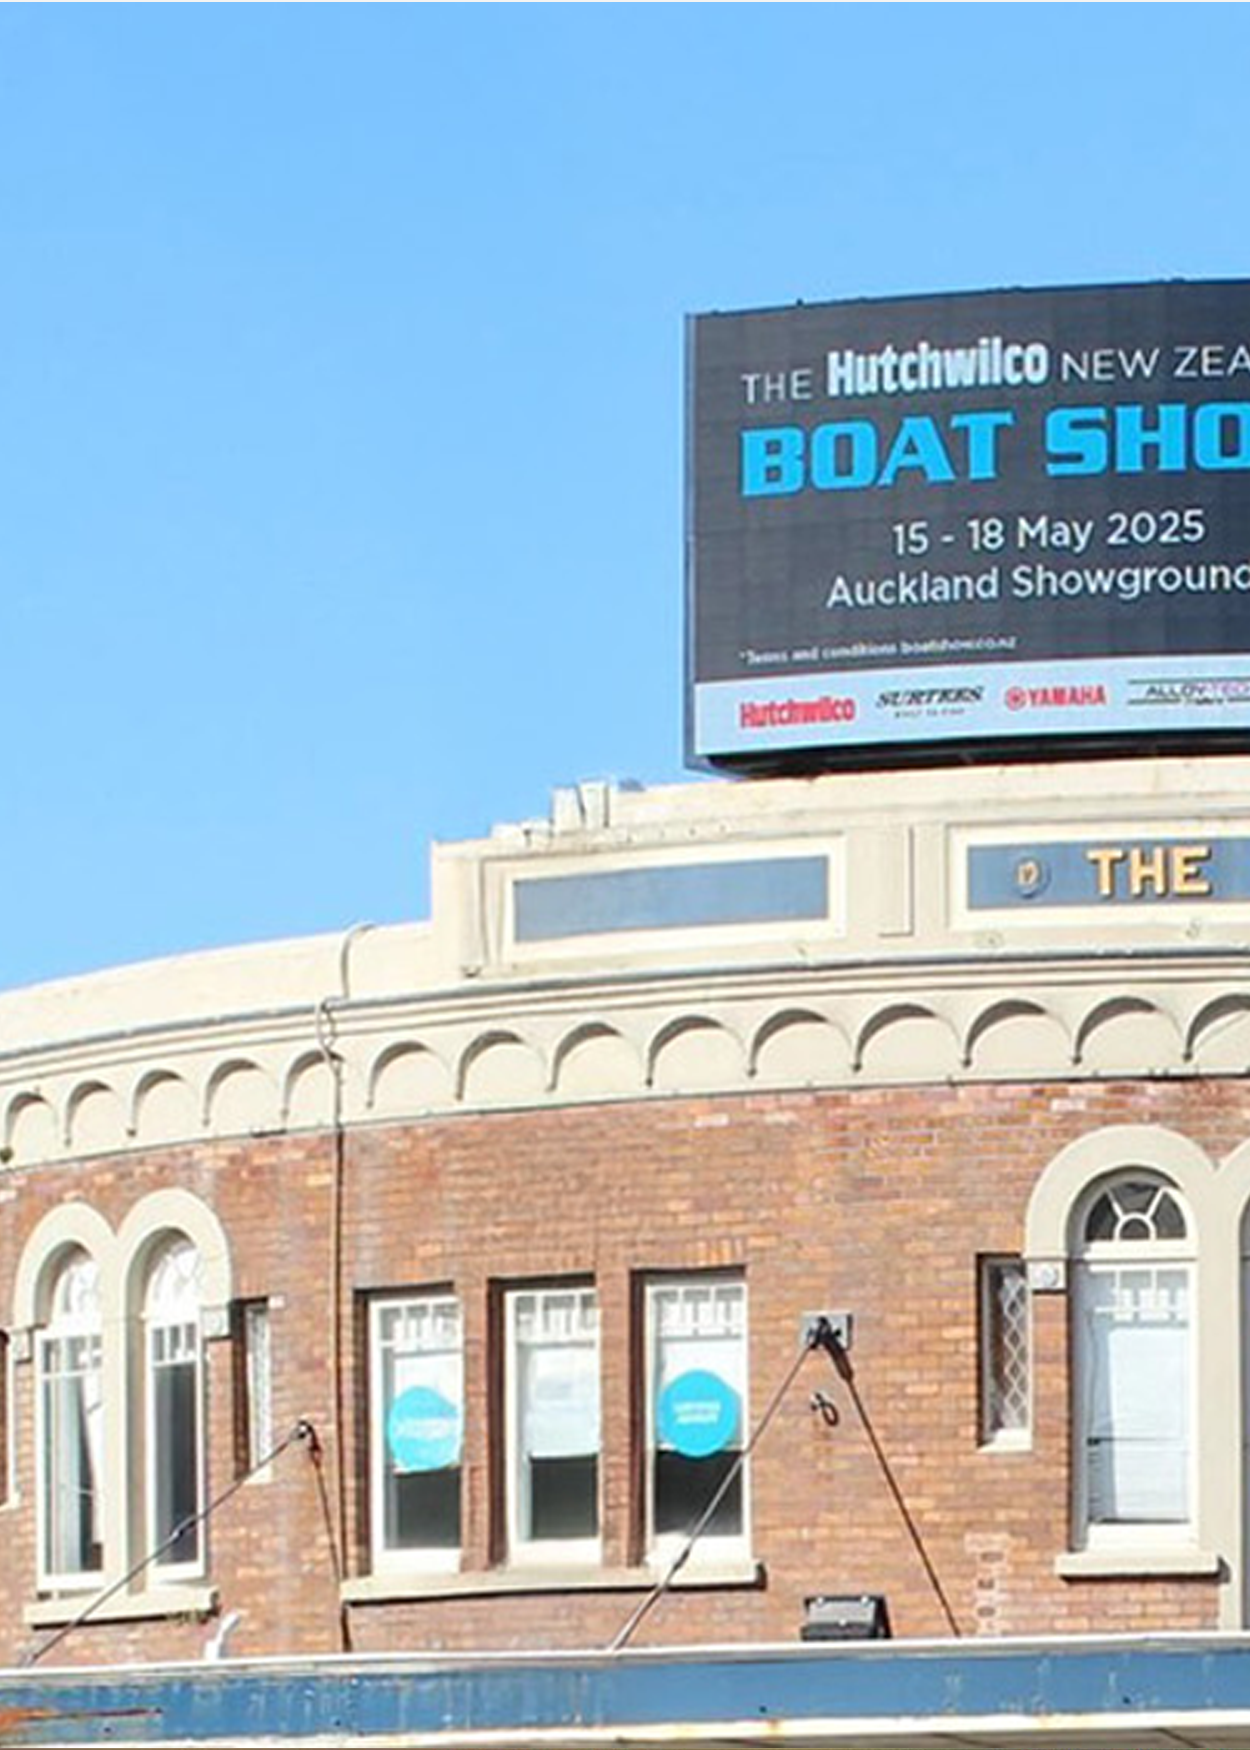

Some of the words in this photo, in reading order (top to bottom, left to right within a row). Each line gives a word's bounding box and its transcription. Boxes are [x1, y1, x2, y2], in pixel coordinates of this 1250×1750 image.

[741, 368, 814, 404] THE
[827, 337, 1050, 398] Hutchwilco
[1061, 347, 1161, 382] NEW
[740, 412, 1014, 498] BOAT
[893, 522, 927, 556] 15
[967, 519, 1004, 551] 18
[1017, 516, 1095, 554] May
[1107, 510, 1206, 544] 2025
[826, 565, 1000, 609] Auckland
[739, 695, 856, 728] Hutchwilco
[875, 685, 985, 708] SURTEES
[1027, 684, 1106, 708] YAMAHA
[1087, 845, 1211, 897] THE
